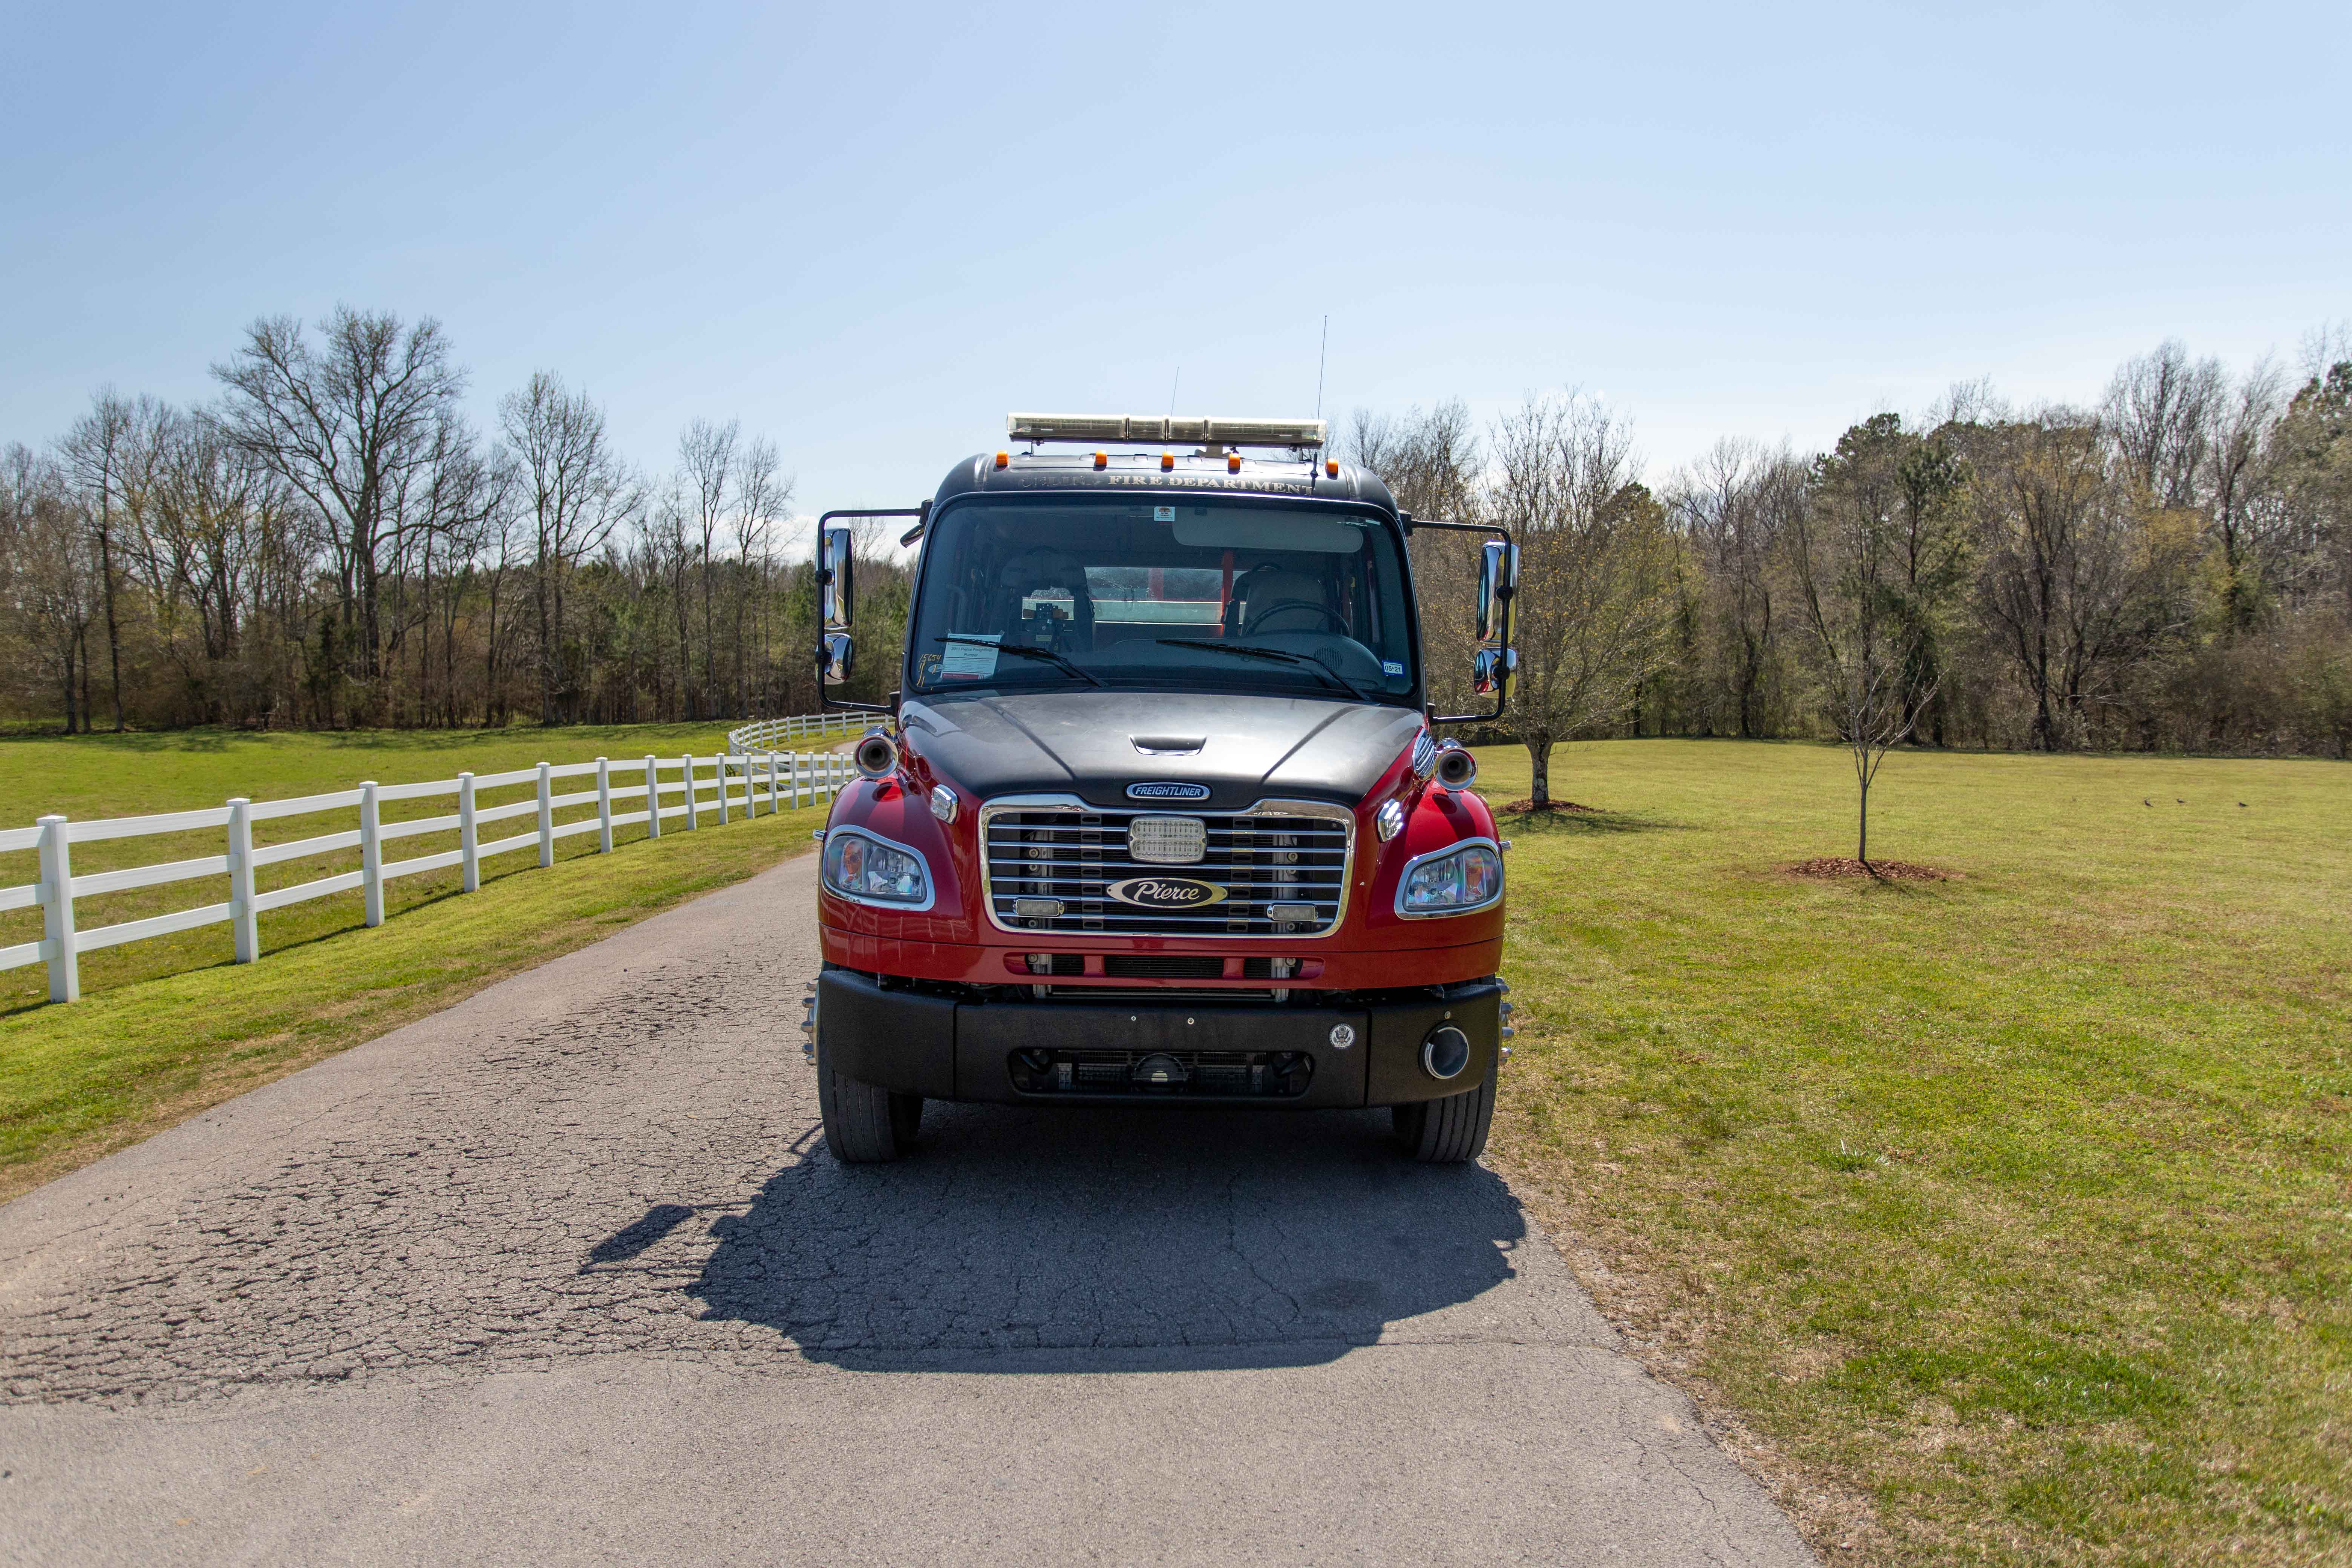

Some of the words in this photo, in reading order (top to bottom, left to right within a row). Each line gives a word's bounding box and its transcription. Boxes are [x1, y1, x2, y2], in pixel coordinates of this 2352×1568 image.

[1108, 476, 1163, 485] FIRE
[1169, 477, 1312, 496] DEPARTMENT
[1135, 786, 1201, 796] FREIGHTLINER
[1133, 881, 1200, 901] Pierce
